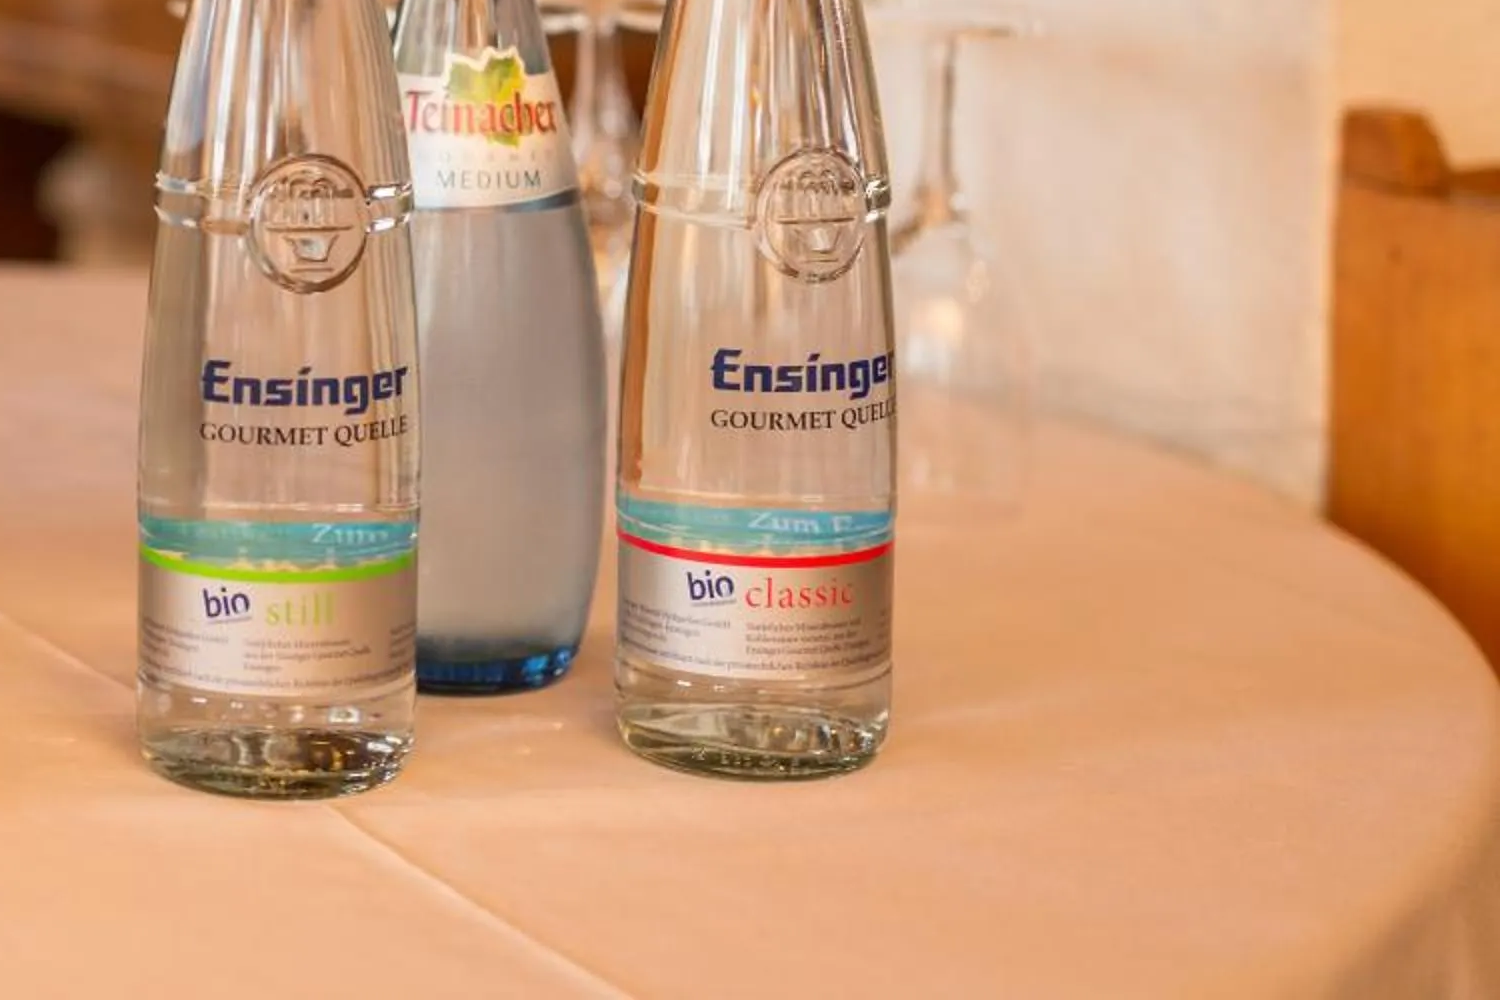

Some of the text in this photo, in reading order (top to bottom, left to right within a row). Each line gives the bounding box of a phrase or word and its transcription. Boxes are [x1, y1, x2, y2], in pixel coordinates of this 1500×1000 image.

[437, 169, 542, 189] MEDIUM
[202, 359, 408, 416] Ensinger
[200, 414, 408, 448] GOURMET QUELLE
[711, 409, 836, 430] GOURMET
[202, 586, 336, 627] bio still
[687, 569, 855, 609] bio classic
